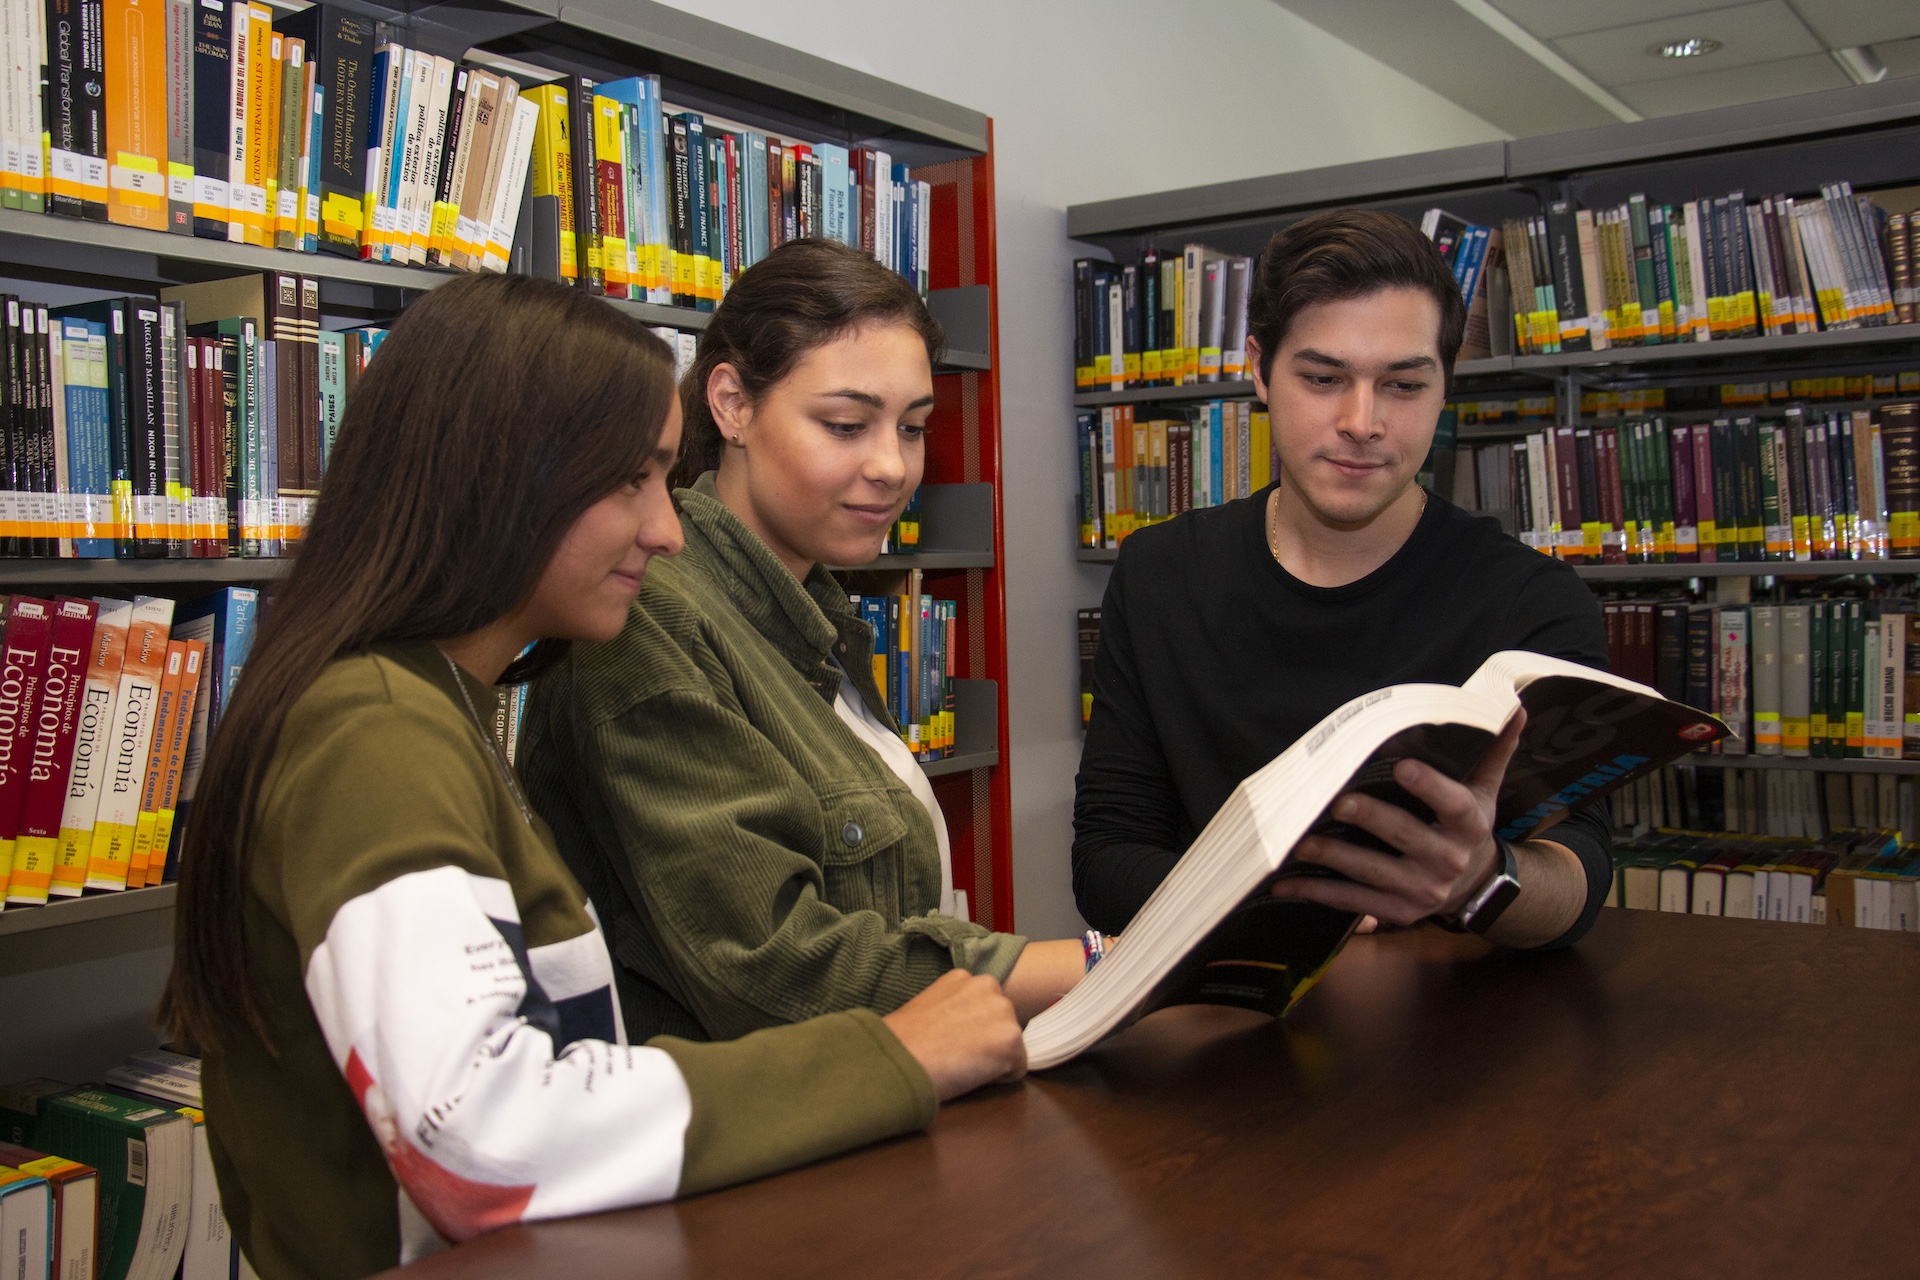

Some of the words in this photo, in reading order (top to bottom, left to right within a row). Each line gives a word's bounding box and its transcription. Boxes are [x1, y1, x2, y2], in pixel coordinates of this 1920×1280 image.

[204, 14, 222, 23] ABBA
[204, 20, 222, 30] EBAN
[59, 20, 72, 62] Global
[83, 30, 89, 39] DE
[198, 42, 212, 50] THE
[212, 46, 228, 54] NEW
[174, 36, 182, 63] Baptiste
[195, 46, 230, 60] DIPLOMACY
[237, 66, 245, 78] DEL
[336, 58, 346, 104] MODERN
[348, 60, 358, 78] The
[392, 78, 398, 88] DE
[236, 79, 244, 108] MODELOS
[254, 62, 264, 146] INTERNACIONALES
[346, 80, 357, 111] Oxford
[236, 108, 244, 120] LOS
[236, 126, 244, 146] Smith
[333, 105, 344, 168] DIPLOMACY
[344, 112, 355, 160] Handbook
[386, 120, 394, 147] POLÍTICA
[408, 132, 414, 144] de
[429, 137, 436, 149] de
[235, 146, 244, 162] Tony
[384, 157, 390, 166] EN
[386, 148, 391, 156] LA
[403, 146, 413, 182] méxico
[410, 144, 420, 185] exterior
[445, 151, 454, 180] ORGULLOS
[556, 152, 566, 170] RISK
[342, 161, 352, 176] of
[423, 150, 434, 186] méxico
[431, 148, 440, 189] exterior
[697, 145, 706, 209] INTERNATIONAL
[54, 194, 82, 206] Stanford
[676, 154, 684, 229] Internacionales
[800, 179, 808, 205] Basel
[828, 188, 836, 230] Financial
[700, 211, 708, 247] FINANCE
[910, 202, 918, 246] Monetary
[910, 247, 918, 272] Policy
[328, 394, 336, 423] PAÍSES
[147, 430, 156, 458] NIXON
[246, 411, 255, 452] TÉCNICA
[1104, 438, 1112, 454] FAIR
[1238, 420, 1248, 498] MACROECONOMICS
[148, 460, 156, 470] IN
[248, 457, 255, 470] DE
[236, 599, 250, 634] Parkin
[98, 632, 113, 667] Mankiw
[140, 630, 155, 664] Mankiw
[1884, 666, 1895, 694] ROMANO
[21, 676, 38, 724] Principios
[64, 674, 81, 721] Principios
[30, 644, 80, 782] Economía
[95, 706, 107, 744] PRINCIPIOS
[140, 702, 149, 740] PRINCIPIOS
[153, 690, 172, 752] Fundamentos
[172, 689, 192, 752] Fundamentos
[18, 725, 30, 738] de
[62, 722, 73, 734] de
[70, 685, 110, 799] Economía
[114, 682, 152, 794] Economía
[152, 756, 161, 768] de
[170, 754, 180, 766] de
[28, 826, 47, 835] Sexta
